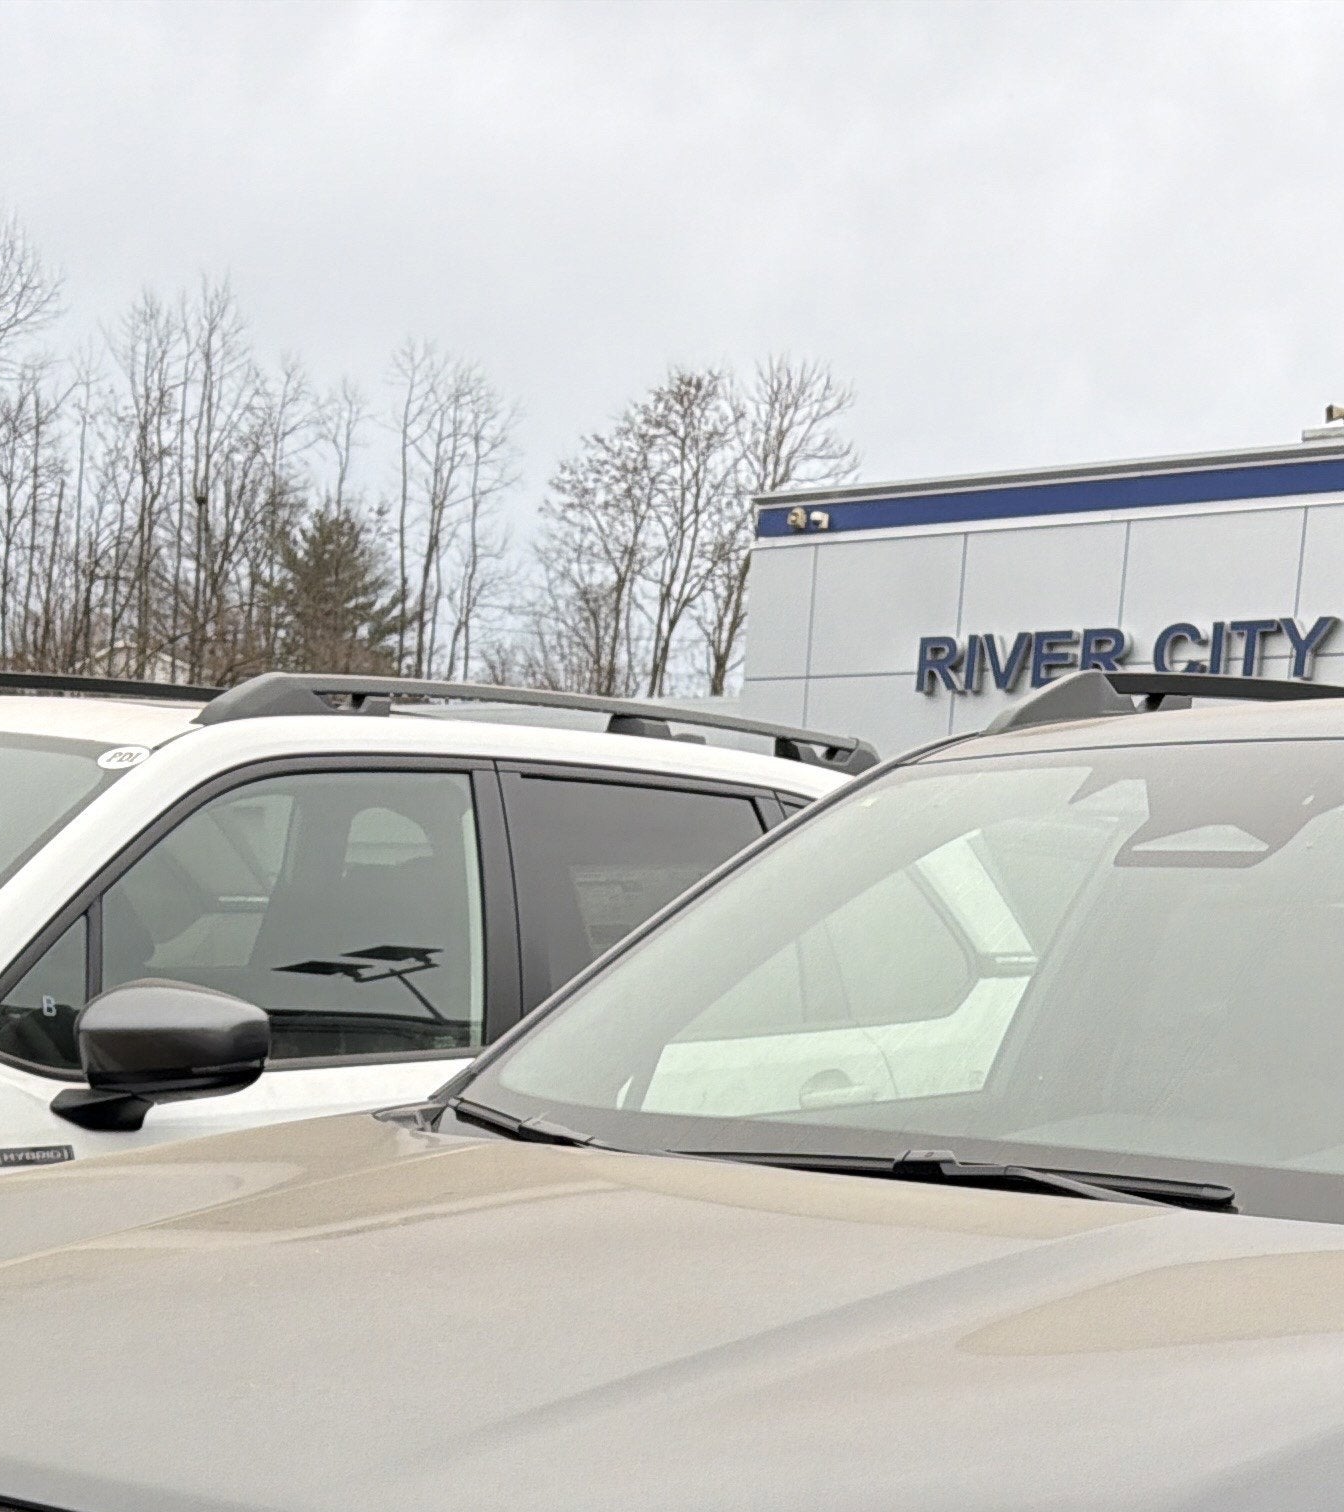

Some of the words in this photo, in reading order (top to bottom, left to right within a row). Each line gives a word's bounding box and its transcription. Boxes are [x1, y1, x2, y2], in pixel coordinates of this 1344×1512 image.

[915, 626, 1131, 694] RIVER
[1153, 616, 1340, 680] CITY
[105, 751, 143, 763] PDI
[42, 994, 57, 1017] B
